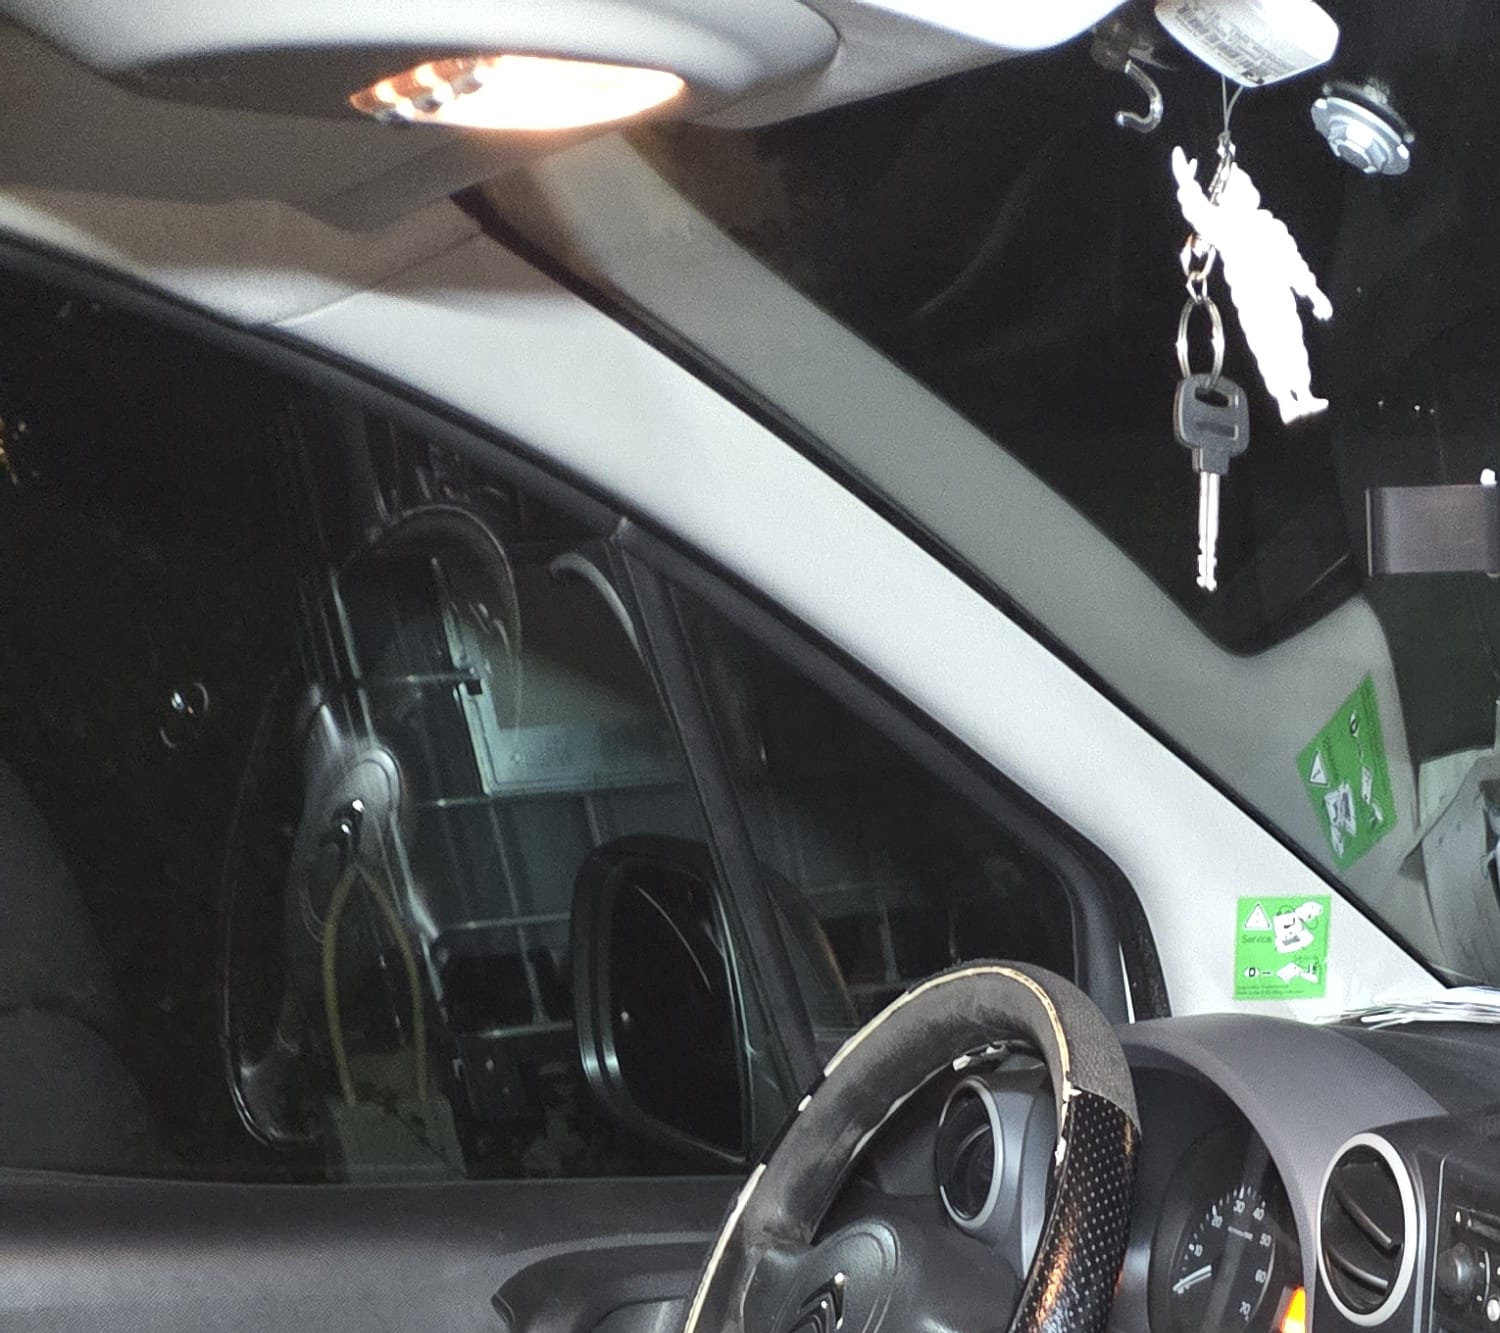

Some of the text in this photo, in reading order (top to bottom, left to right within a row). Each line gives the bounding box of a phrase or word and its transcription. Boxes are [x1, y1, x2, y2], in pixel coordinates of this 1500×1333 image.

[1233, 1200, 1245, 1214] 30
[1253, 1207, 1265, 1221] 40
[1211, 1215, 1223, 1228] 20
[1260, 1233, 1271, 1247] 50
[1255, 1269, 1266, 1283] 60
[1240, 1301, 1251, 1315] 70
